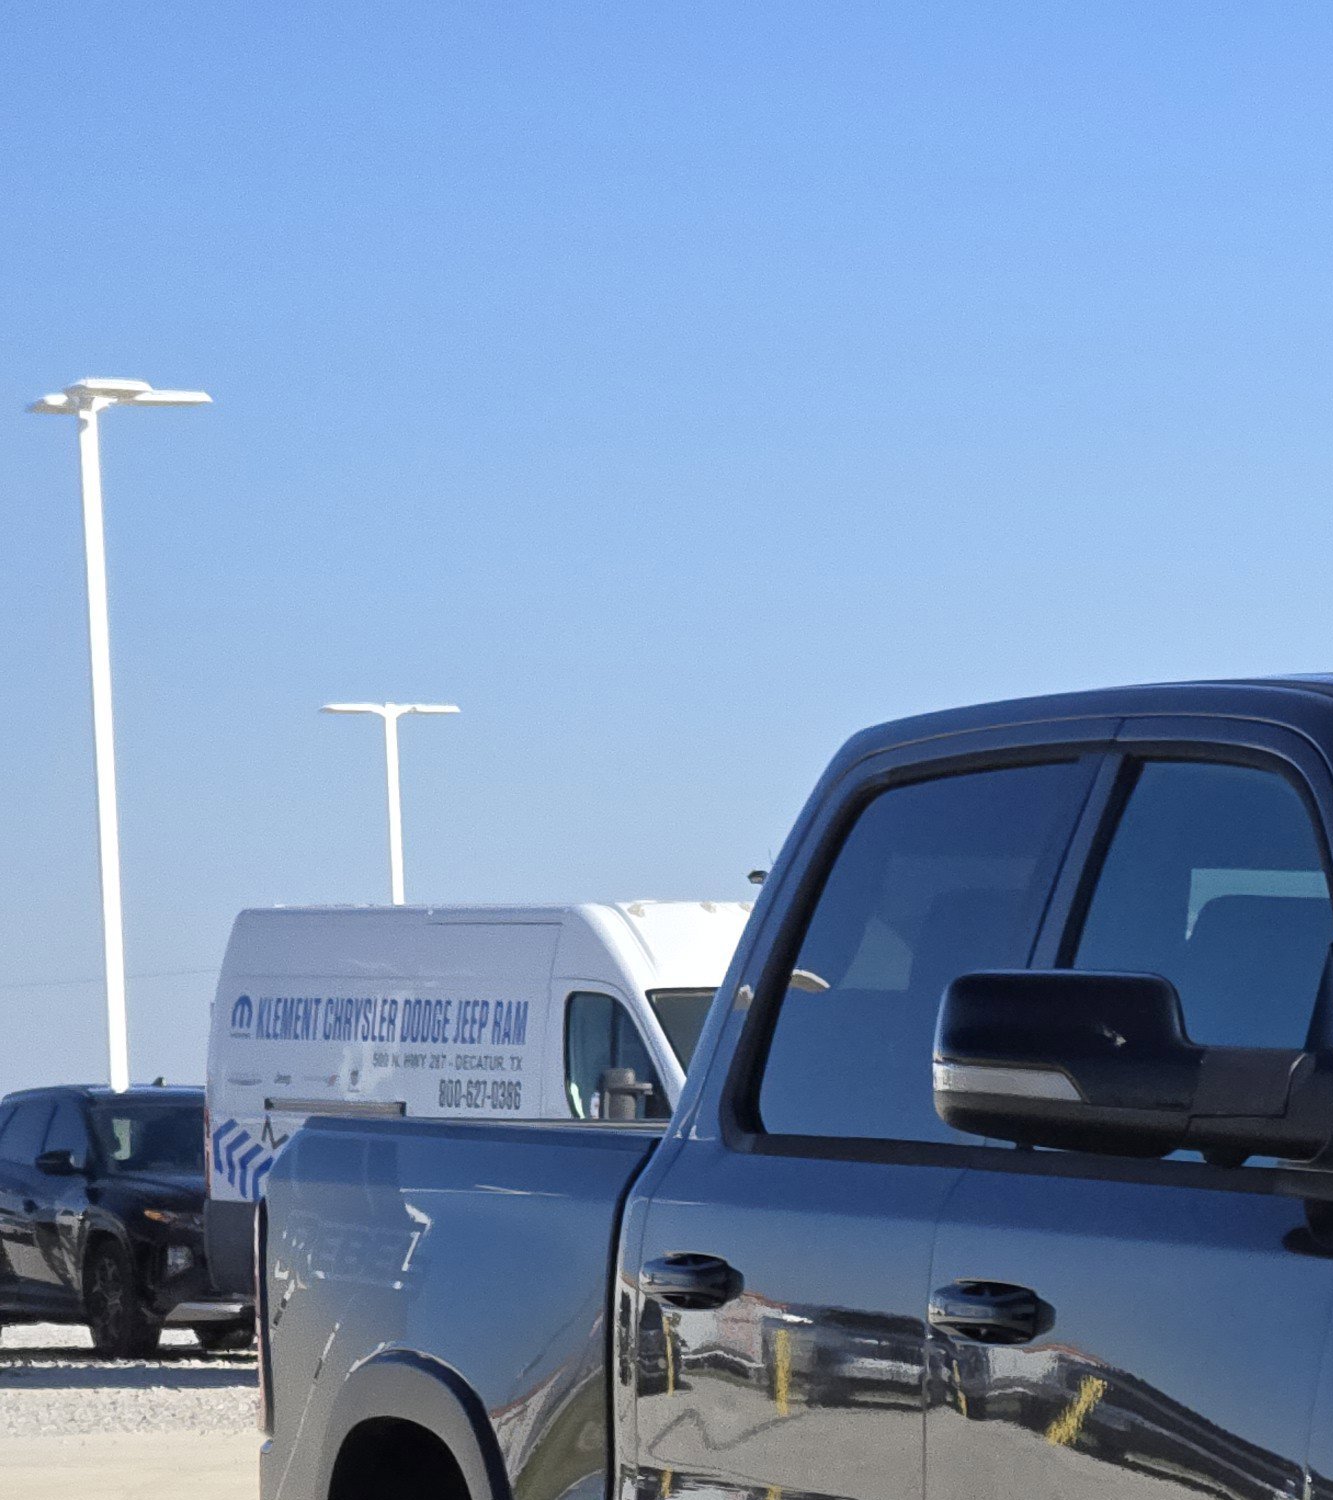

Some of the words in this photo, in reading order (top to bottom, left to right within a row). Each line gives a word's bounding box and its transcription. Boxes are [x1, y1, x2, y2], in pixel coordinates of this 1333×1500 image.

[256, 997, 322, 1041] KLEMENT
[323, 998, 399, 1042] CHRYSLER
[401, 999, 452, 1044] DODGE
[453, 1000, 490, 1045] JEEP
[492, 1000, 529, 1046] RAM
